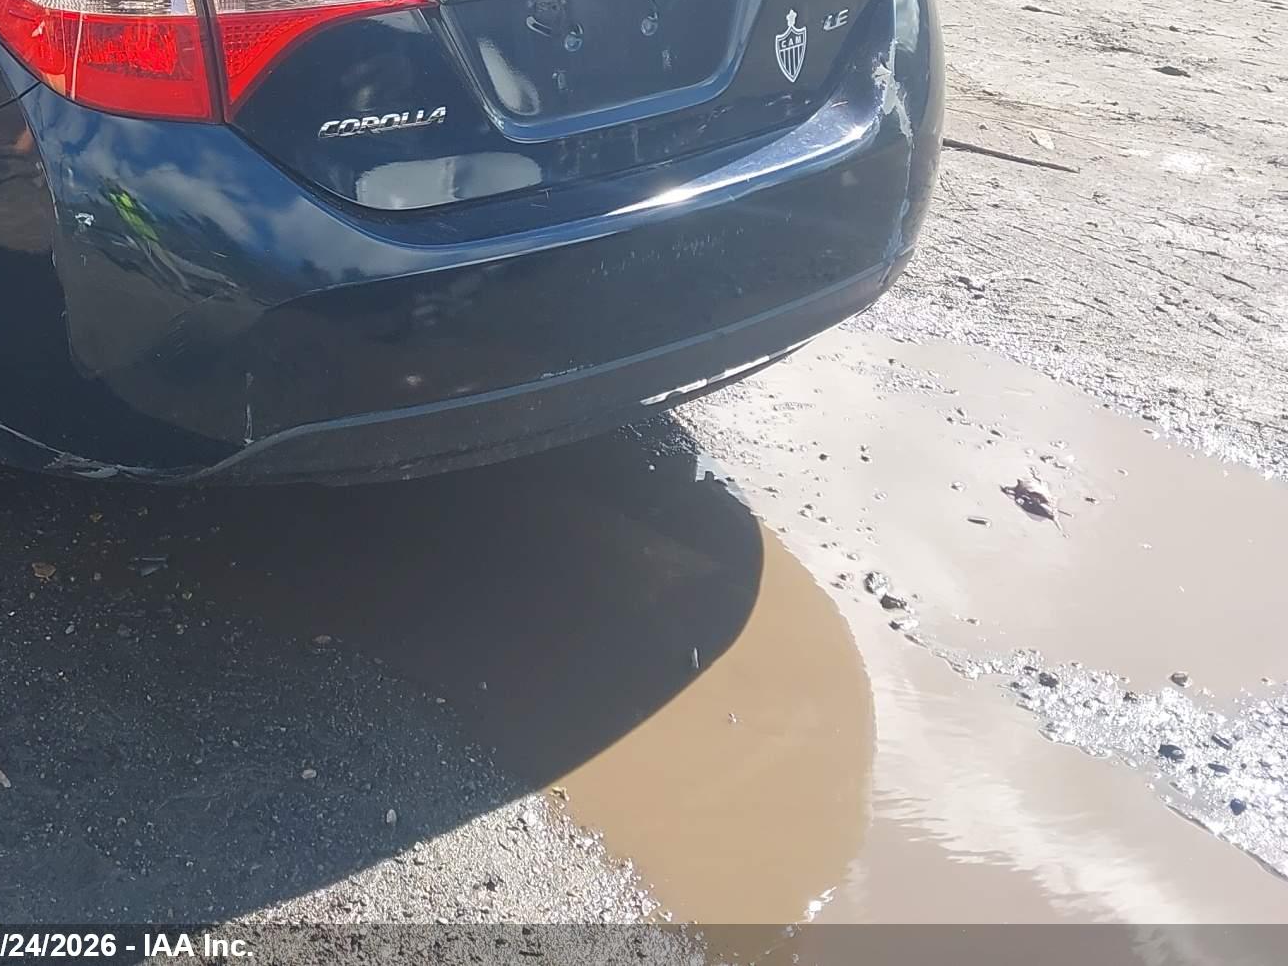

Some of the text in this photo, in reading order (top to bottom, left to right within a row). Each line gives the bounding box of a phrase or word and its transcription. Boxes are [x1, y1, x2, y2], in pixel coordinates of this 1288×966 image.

[823, 9, 849, 31] LE
[781, 35, 803, 48] CAM
[318, 106, 447, 138] COROLLA
